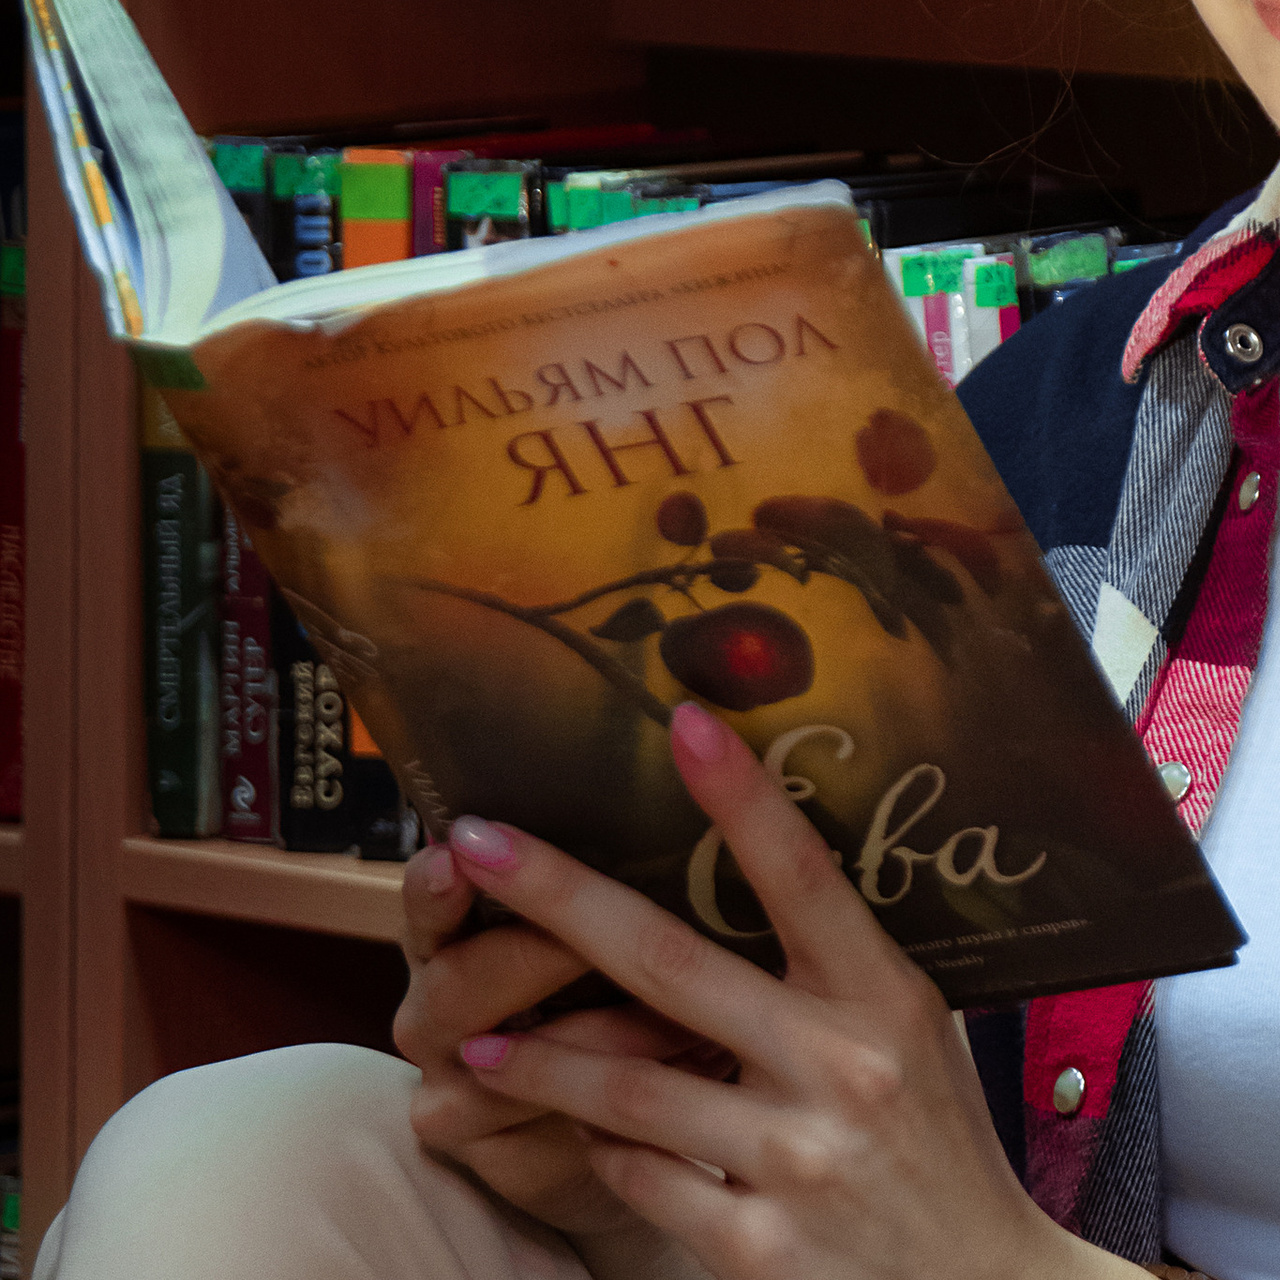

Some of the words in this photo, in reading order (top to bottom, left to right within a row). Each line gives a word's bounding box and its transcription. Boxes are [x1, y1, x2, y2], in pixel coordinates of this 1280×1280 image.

[334, 349, 652, 449] УИЛЬЯМ
[664, 313, 839, 380] ПОЛ
[506, 394, 740, 507] ЯНГ
